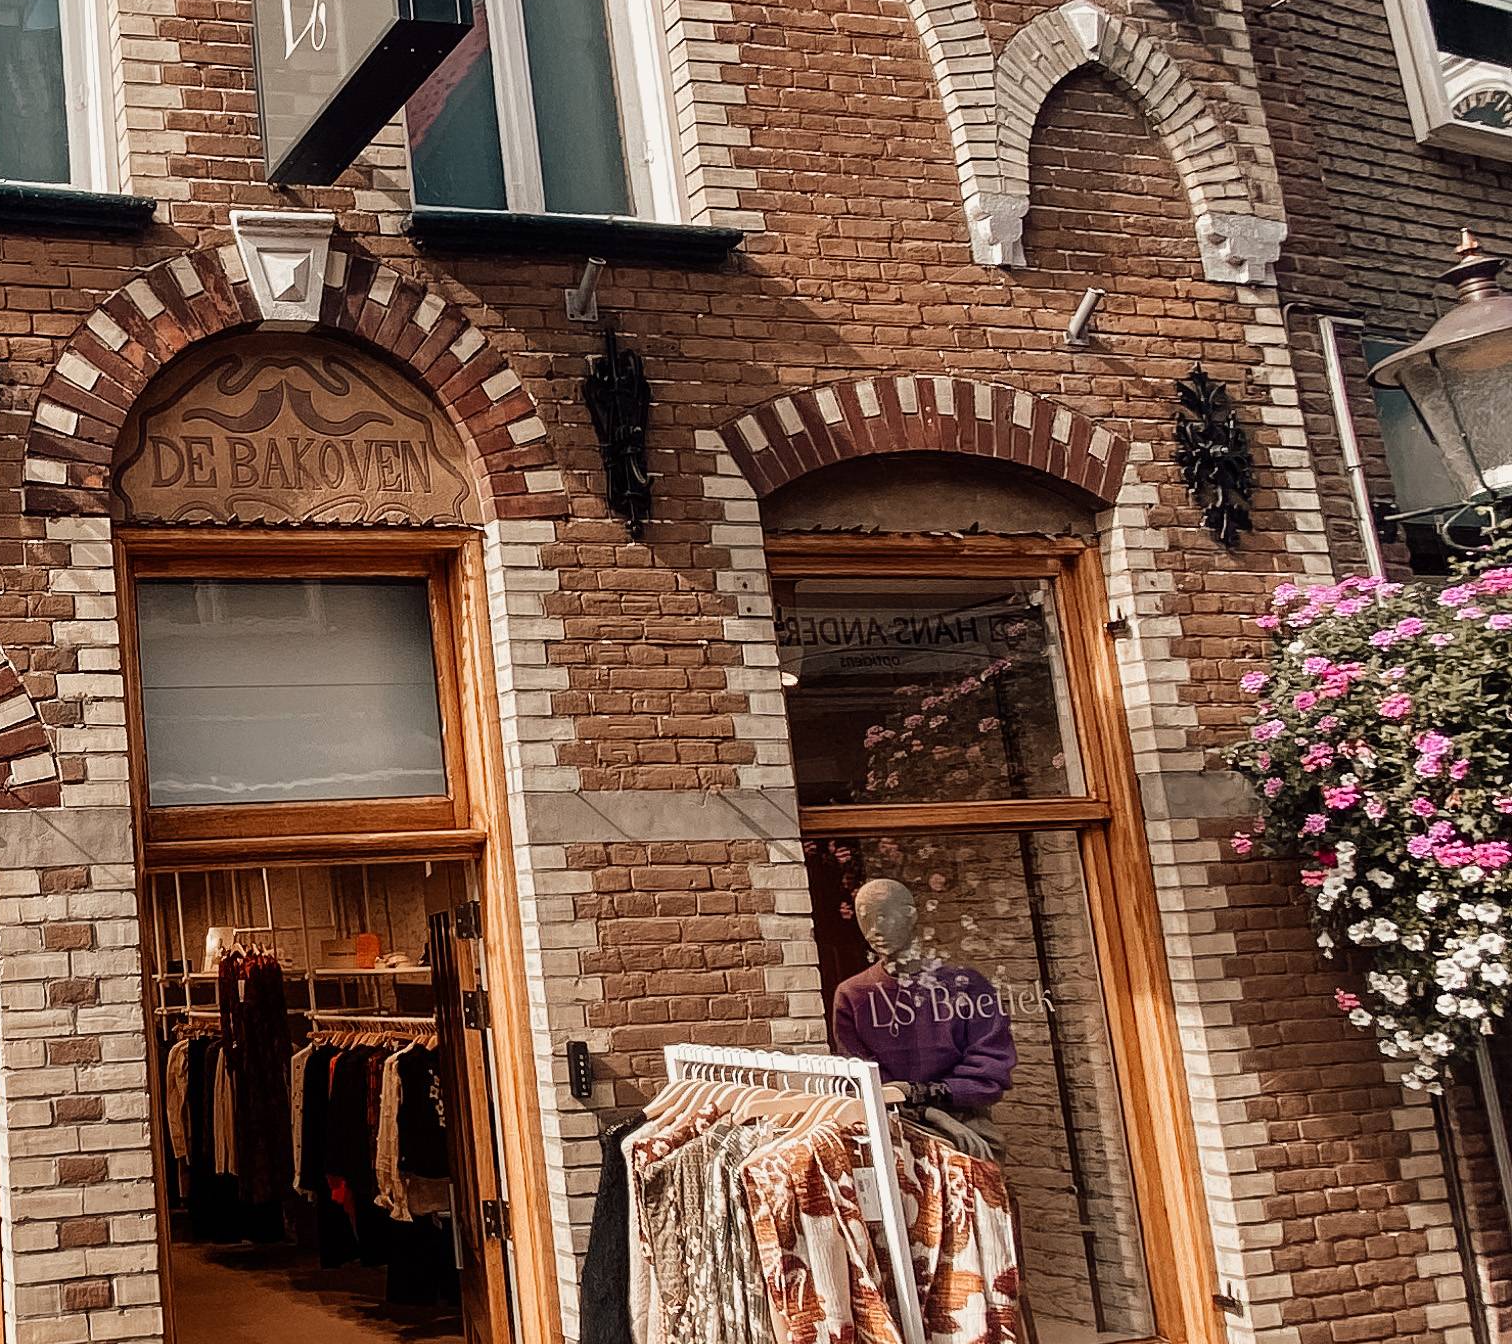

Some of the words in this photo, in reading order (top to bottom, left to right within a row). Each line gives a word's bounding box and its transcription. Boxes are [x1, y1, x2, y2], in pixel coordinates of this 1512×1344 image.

[148, 435, 218, 489] DE
[225, 436, 432, 494] BAKOVEN
[929, 979, 1056, 1023] Boetiek
